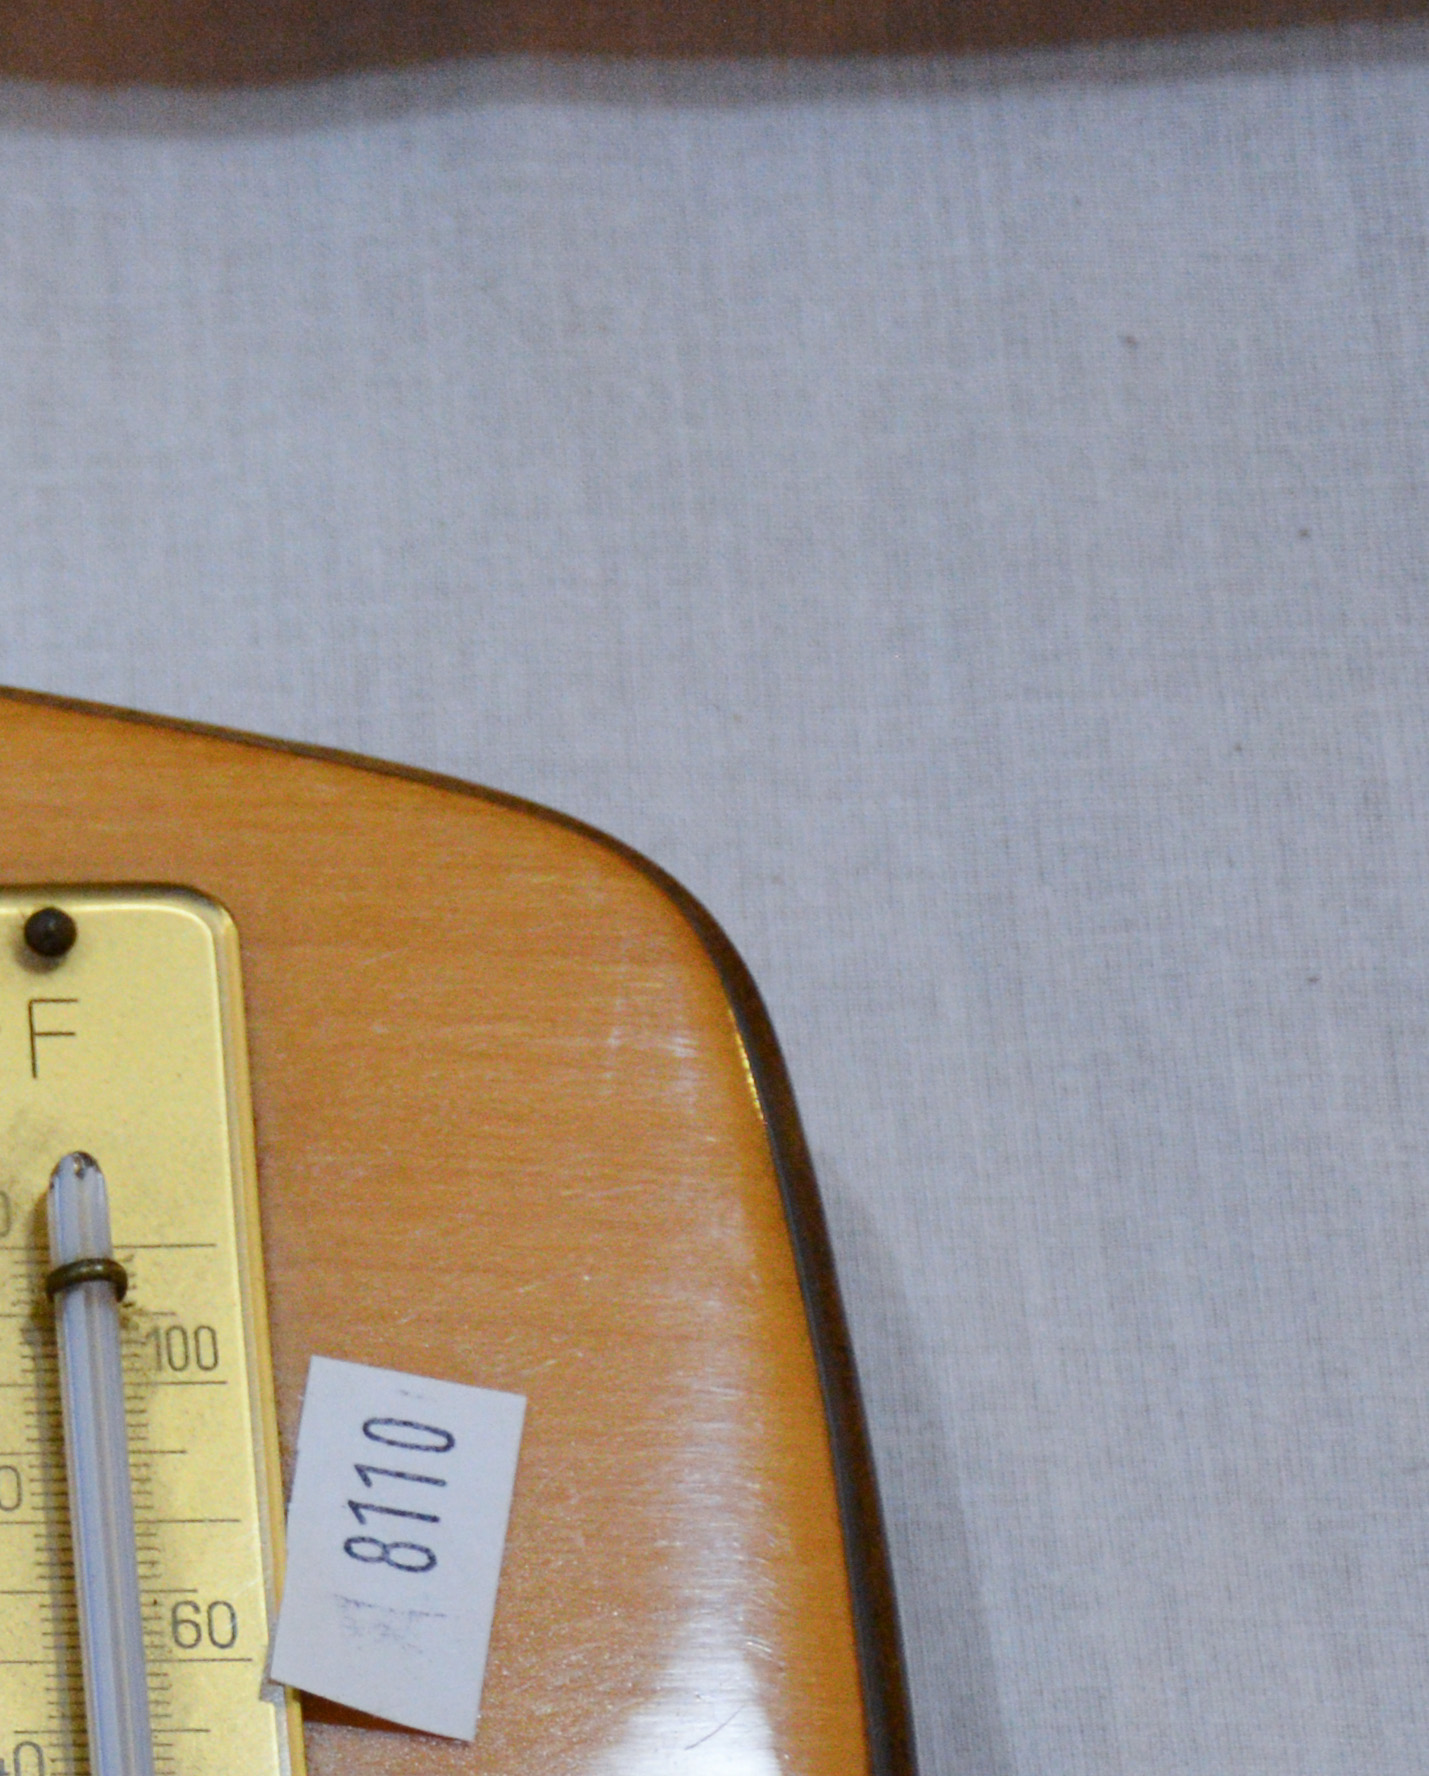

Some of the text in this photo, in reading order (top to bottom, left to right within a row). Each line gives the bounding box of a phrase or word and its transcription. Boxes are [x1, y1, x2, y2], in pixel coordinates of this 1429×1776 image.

[26, 997, 80, 1079] F
[149, 1323, 220, 1374] 100
[344, 1416, 456, 1574] 8110
[170, 1599, 239, 1652] 60
